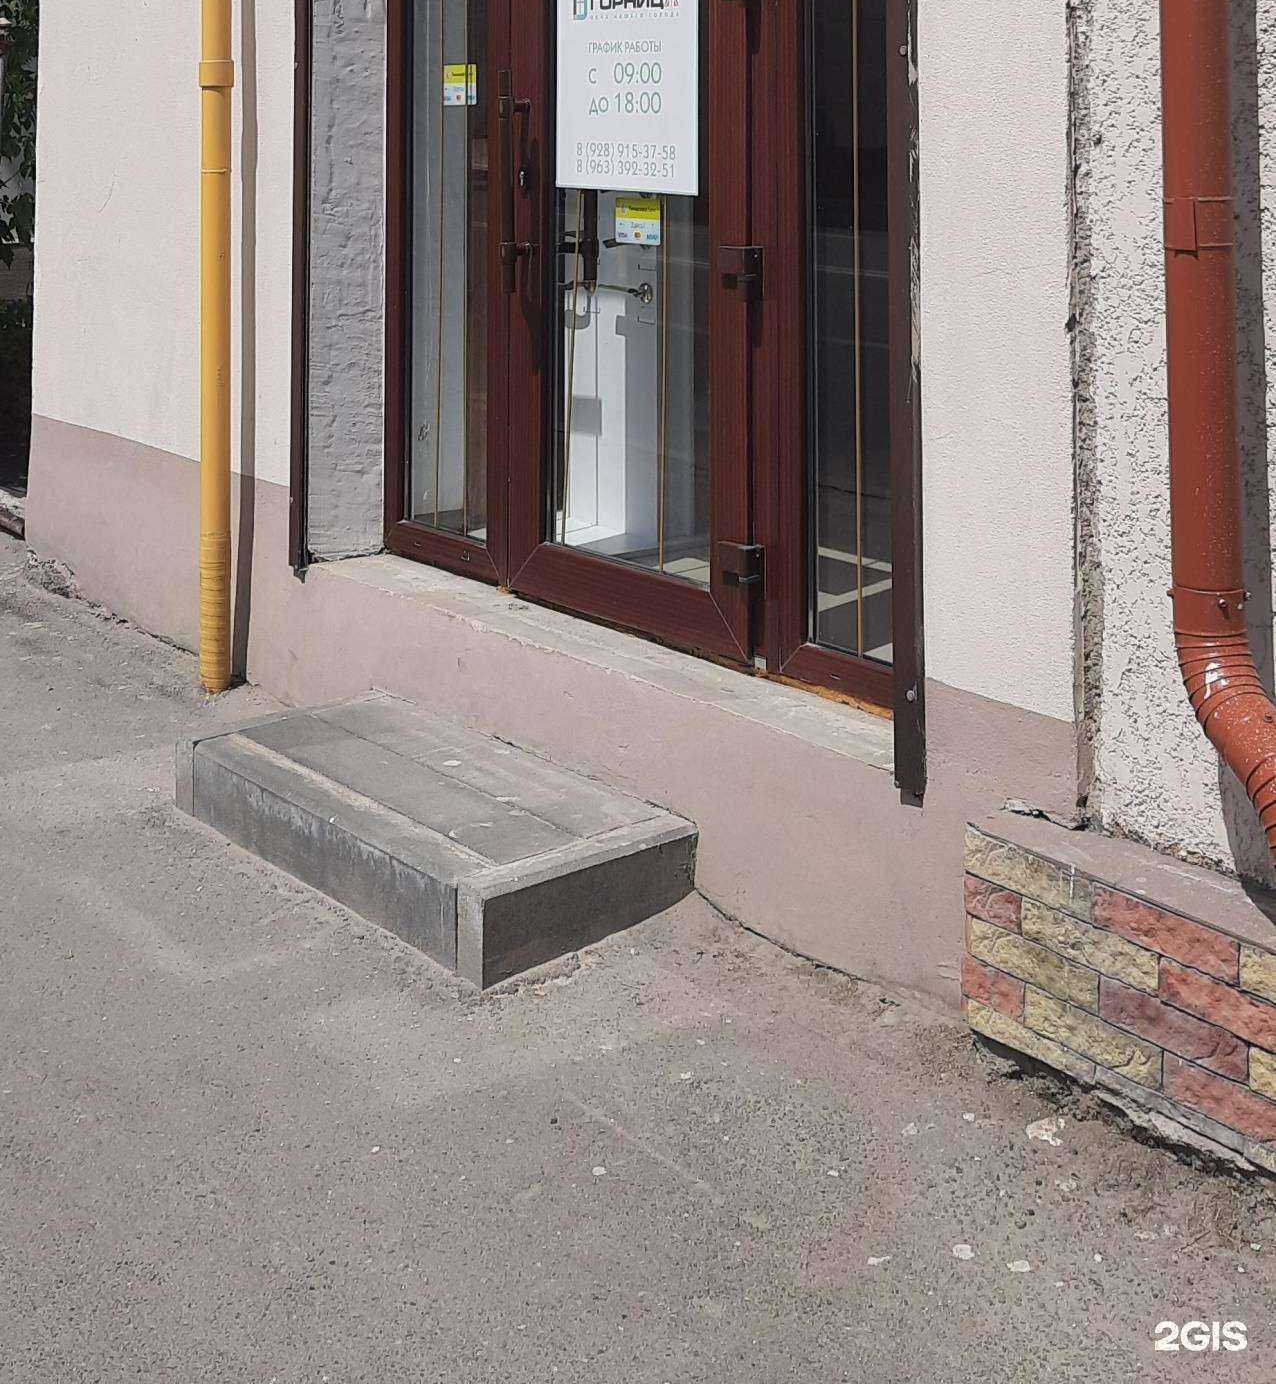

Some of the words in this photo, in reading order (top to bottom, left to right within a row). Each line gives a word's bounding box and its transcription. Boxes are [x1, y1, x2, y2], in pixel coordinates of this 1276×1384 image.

[588, 41, 622, 54] ГРАФИК
[624, 40, 662, 53] РАБОТЫ
[613, 62, 662, 84] 09:00
[614, 91, 662, 114] 18:00
[576, 142, 583, 156] 8
[585, 142, 615, 160] (928)
[617, 143, 676, 161] 915-37-58
[576, 159, 583, 173] 8
[585, 159, 615, 175] (963)
[617, 160, 675, 178] 392-32-51
